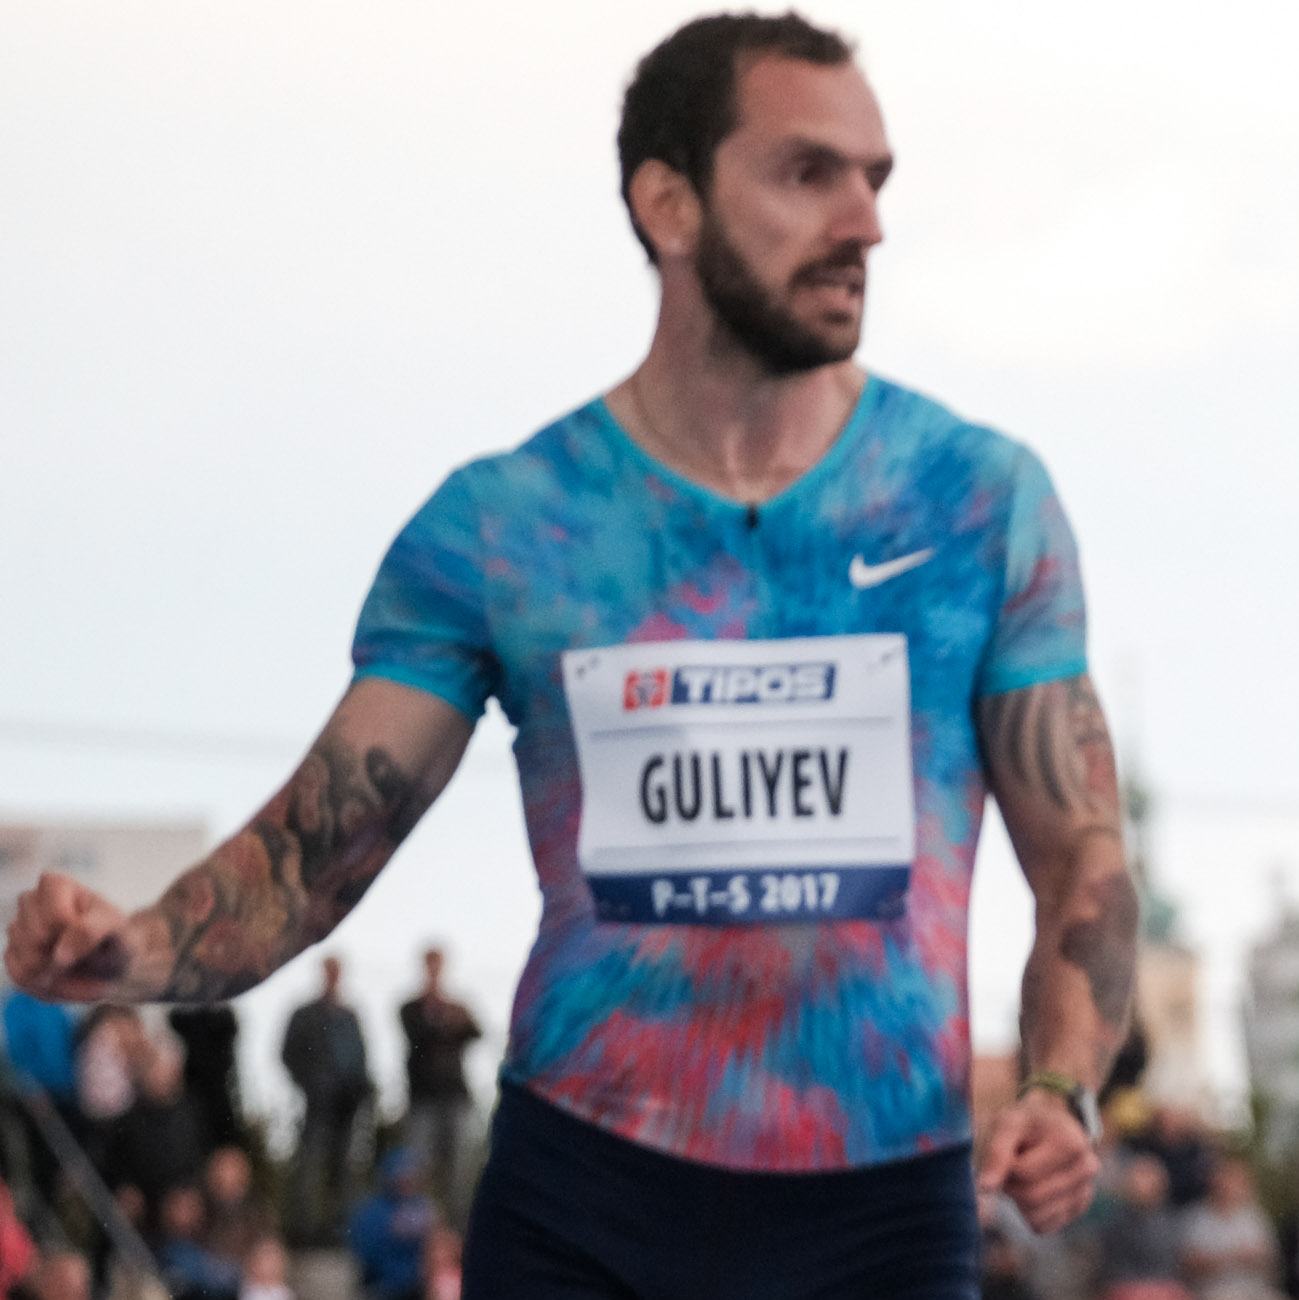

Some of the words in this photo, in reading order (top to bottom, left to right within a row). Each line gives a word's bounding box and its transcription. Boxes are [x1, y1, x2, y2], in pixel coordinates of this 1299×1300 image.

[678, 665, 824, 702] TIPOS
[640, 747, 848, 823] GULIYEV
[761, 872, 839, 912] 2017
